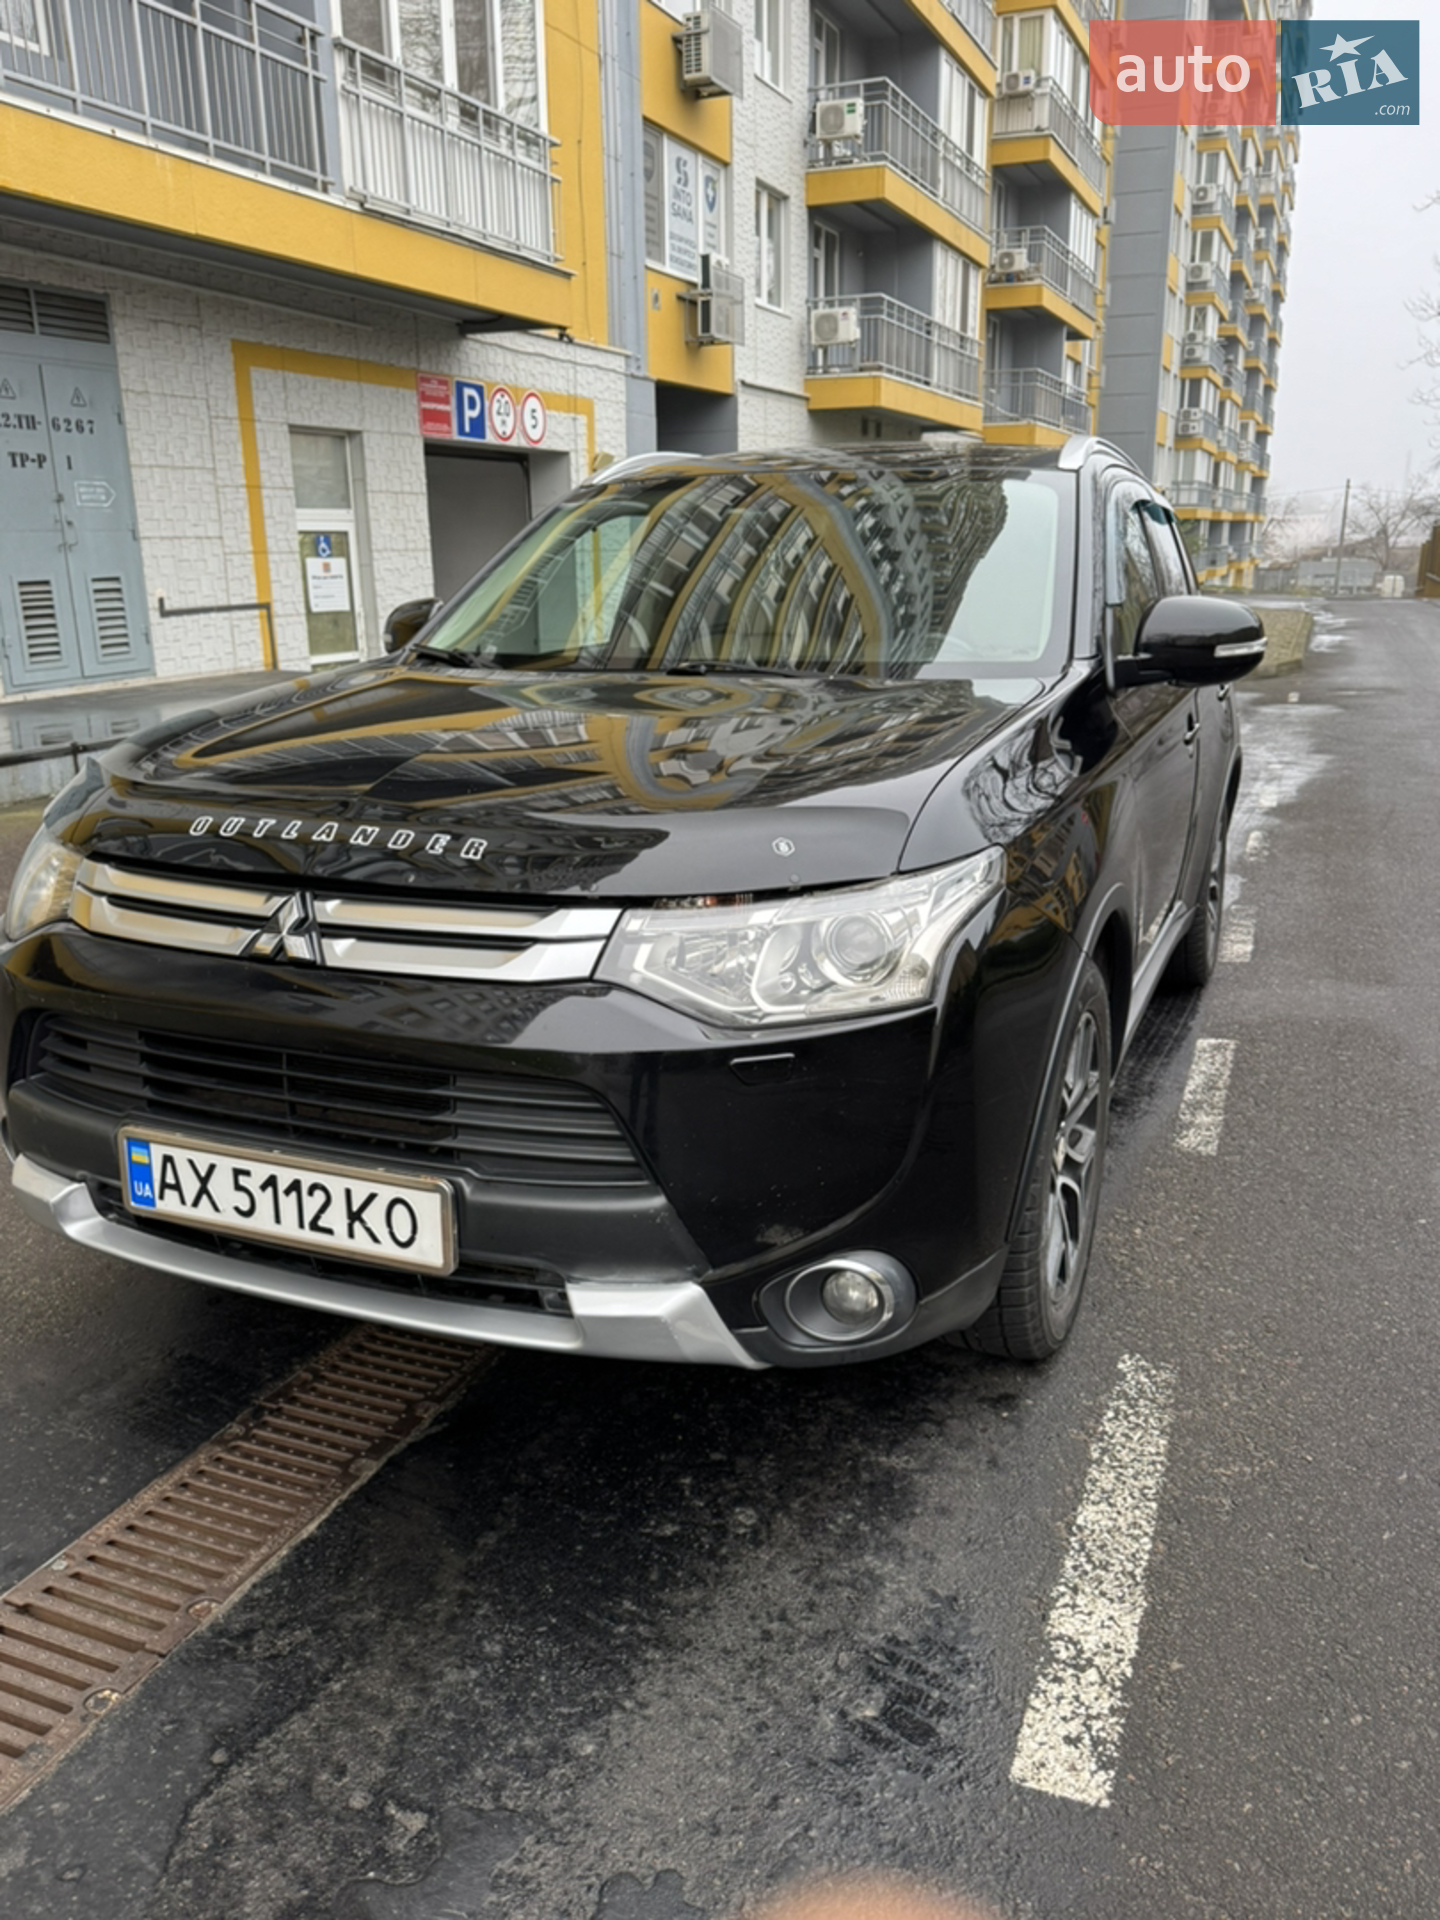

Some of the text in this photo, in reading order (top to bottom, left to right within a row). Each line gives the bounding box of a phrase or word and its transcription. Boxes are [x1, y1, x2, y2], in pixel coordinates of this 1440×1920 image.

[51, 416, 95, 435] 6267
[462, 386, 482, 434] P
[530, 408, 539, 430] 5
[189, 815, 488, 860] OUTLANDER
[133, 1180, 153, 1198] UA
[231, 1166, 335, 1236] 5112
